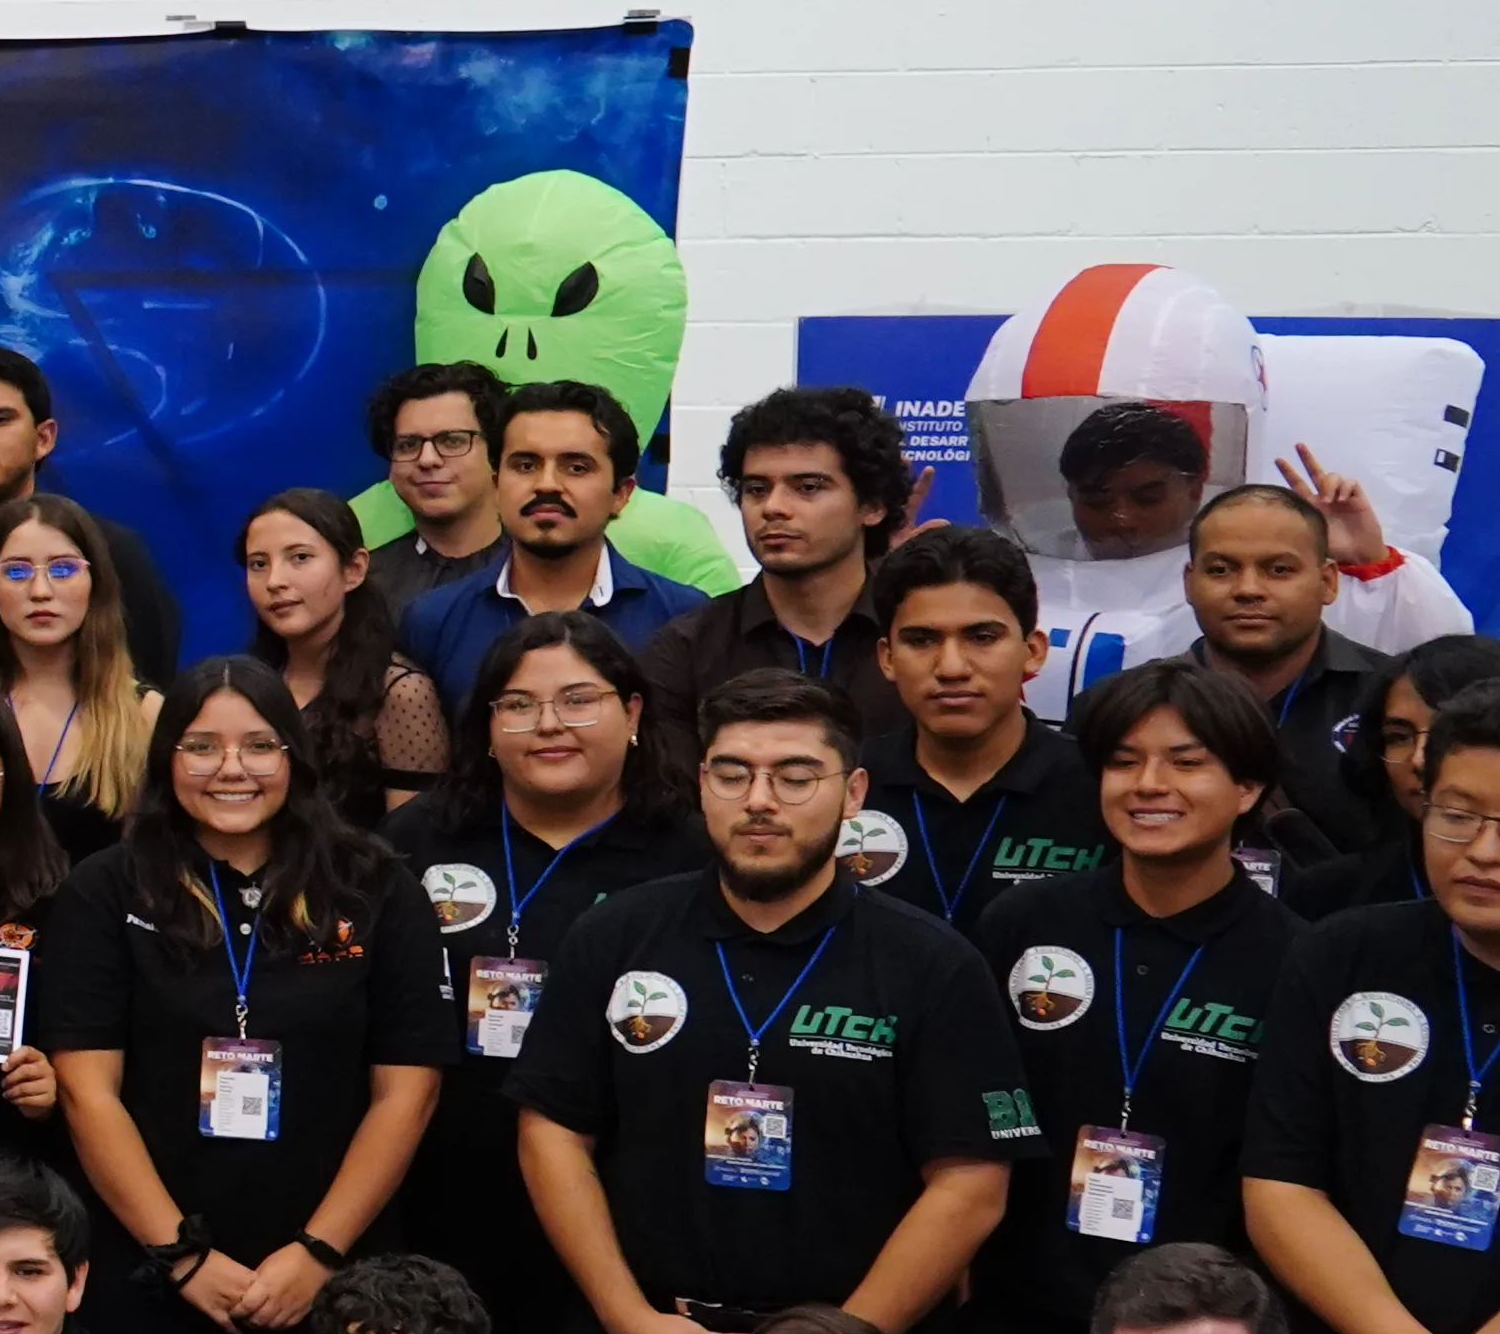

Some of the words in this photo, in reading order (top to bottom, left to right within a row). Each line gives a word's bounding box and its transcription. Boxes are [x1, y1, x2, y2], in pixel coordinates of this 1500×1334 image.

[895, 400, 966, 417] INADE
[899, 420, 964, 432] NSTITUTO
[910, 435, 969, 446] DESARR
[993, 836, 1105, 872] UTCH
[476, 969, 503, 980] RETO
[504, 971, 542, 982] MARTE
[789, 1004, 898, 1043] UTCH
[207, 1050, 234, 1061] RETO
[236, 1052, 273, 1062] MARTE
[714, 1095, 742, 1108] RETO
[744, 1098, 784, 1110] MARTE
[1083, 1139, 1113, 1154] RETO
[1115, 1144, 1156, 1160] MARTE
[1424, 1138, 1455, 1155] RETO
[1457, 1144, 1500, 1162] MARTE
